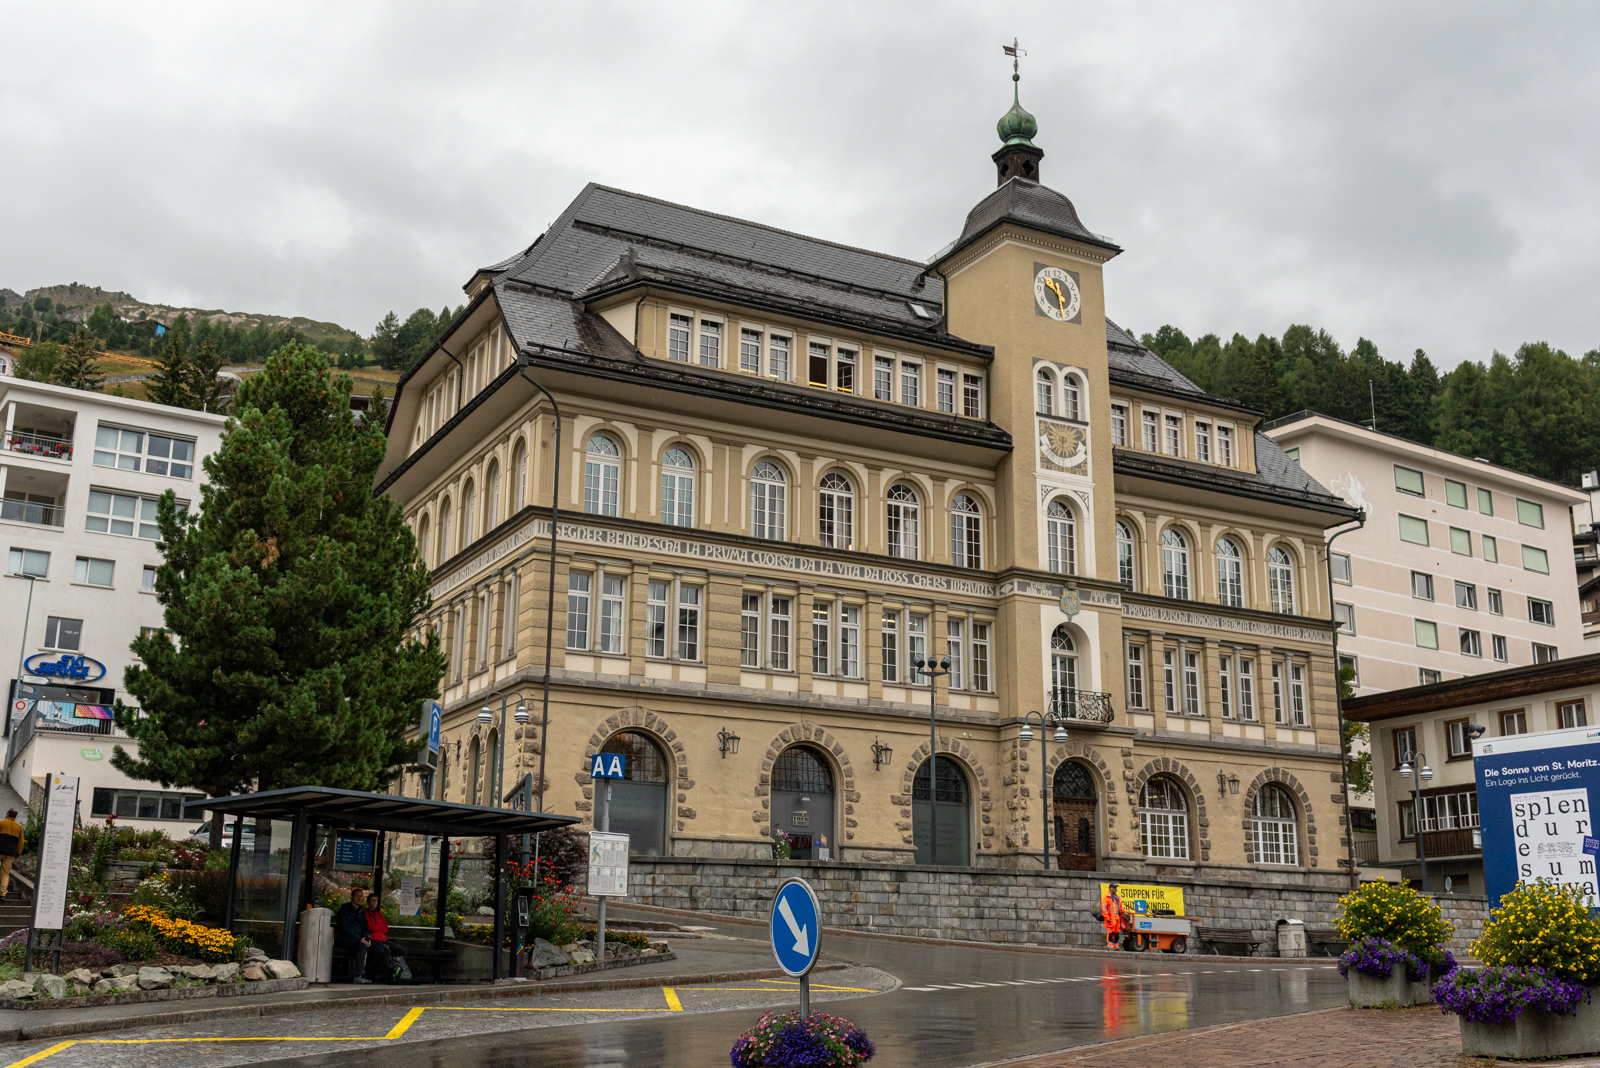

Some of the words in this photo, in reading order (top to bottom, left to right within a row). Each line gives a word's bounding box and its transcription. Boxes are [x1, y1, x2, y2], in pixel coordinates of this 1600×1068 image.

[1053, 270, 1061, 278] 12
[1036, 285, 1042, 293] 9
[1069, 282, 1075, 291] 2
[1040, 296, 1045, 305] 8
[1073, 293, 1078, 302] 3
[1047, 306, 1052, 314] 7
[1055, 310, 1062, 318] 6
[1065, 310, 1070, 318] 5
[1071, 304, 1077, 312] 4
[555, 522, 606, 544] SEGNER
[686, 542, 700, 555] LA
[799, 559, 816, 571] DA
[820, 561, 833, 574] LA
[837, 563, 860, 578] VITA
[864, 566, 879, 580] DA
[57, 654, 85, 667] SKI
[35, 661, 90, 677] SERVICE
[592, 756, 605, 777] A
[607, 756, 623, 777] A
[1484, 768, 1499, 777] Die
[1501, 767, 1530, 776] Sonne
[1532, 764, 1550, 772] von
[1552, 761, 1565, 770] St.
[1567, 758, 1600, 769] Moritz.
[1485, 779, 1497, 787] Ein
[1498, 778, 1517, 787] Logo
[1518, 776, 1529, 784] ins
[1530, 774, 1549, 783] Licht
[1550, 771, 1582, 782] gerückt.
[1515, 796, 1587, 821] splen
[1518, 842, 1530, 857] e
[1120, 888, 1150, 900] STOPPEN
[1151, 888, 1165, 900] FÜR
